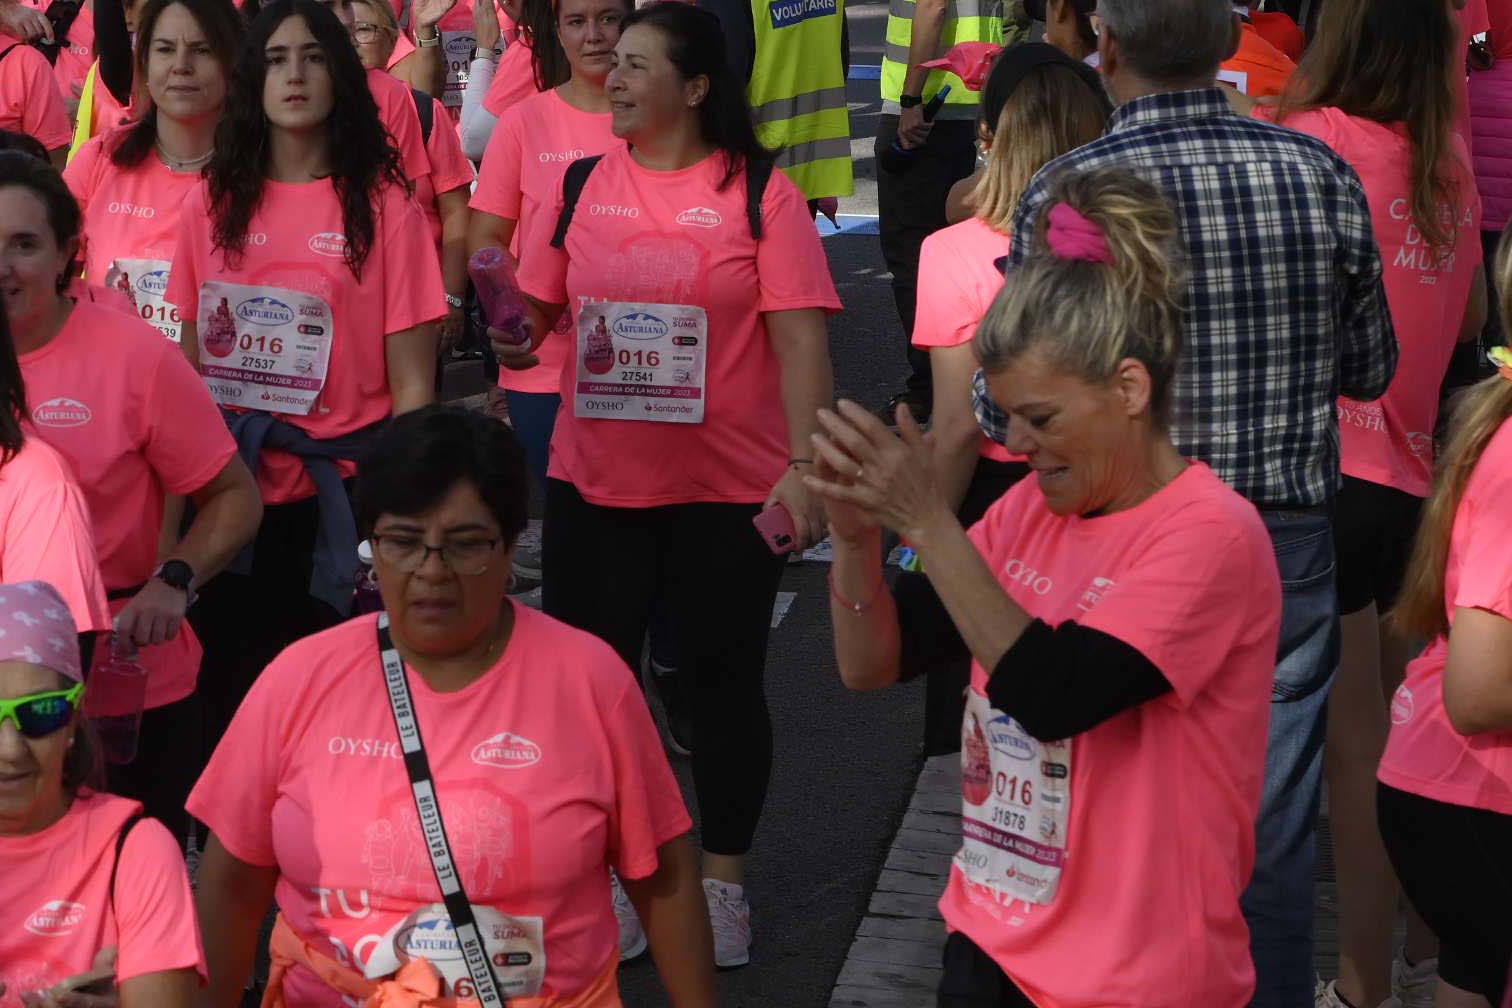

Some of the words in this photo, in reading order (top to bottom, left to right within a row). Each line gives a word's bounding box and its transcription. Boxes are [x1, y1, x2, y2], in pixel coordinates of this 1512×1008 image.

[538, 149, 585, 163] OYSHO
[108, 200, 155, 219] OYSHO
[589, 203, 639, 219] OYSHO
[141, 304, 182, 323] 016
[240, 306, 289, 322] ASTURIANA
[617, 322, 664, 335] ASTURIANA
[239, 334, 284, 354] 016
[241, 356, 276, 370] 27537
[618, 349, 660, 367] 016
[208, 369, 242, 379] CARRERA
[244, 372, 254, 381] DE
[255, 374, 265, 382] LA
[622, 371, 653, 382] 27541
[585, 399, 624, 411] OYSHO
[653, 403, 694, 414] Santander
[387, 661, 410, 719] BATELEUR
[995, 771, 1033, 806] 016
[419, 795, 446, 858] BATELEUR
[437, 863, 453, 880] LE
[464, 938, 496, 1003] BATELEUR
